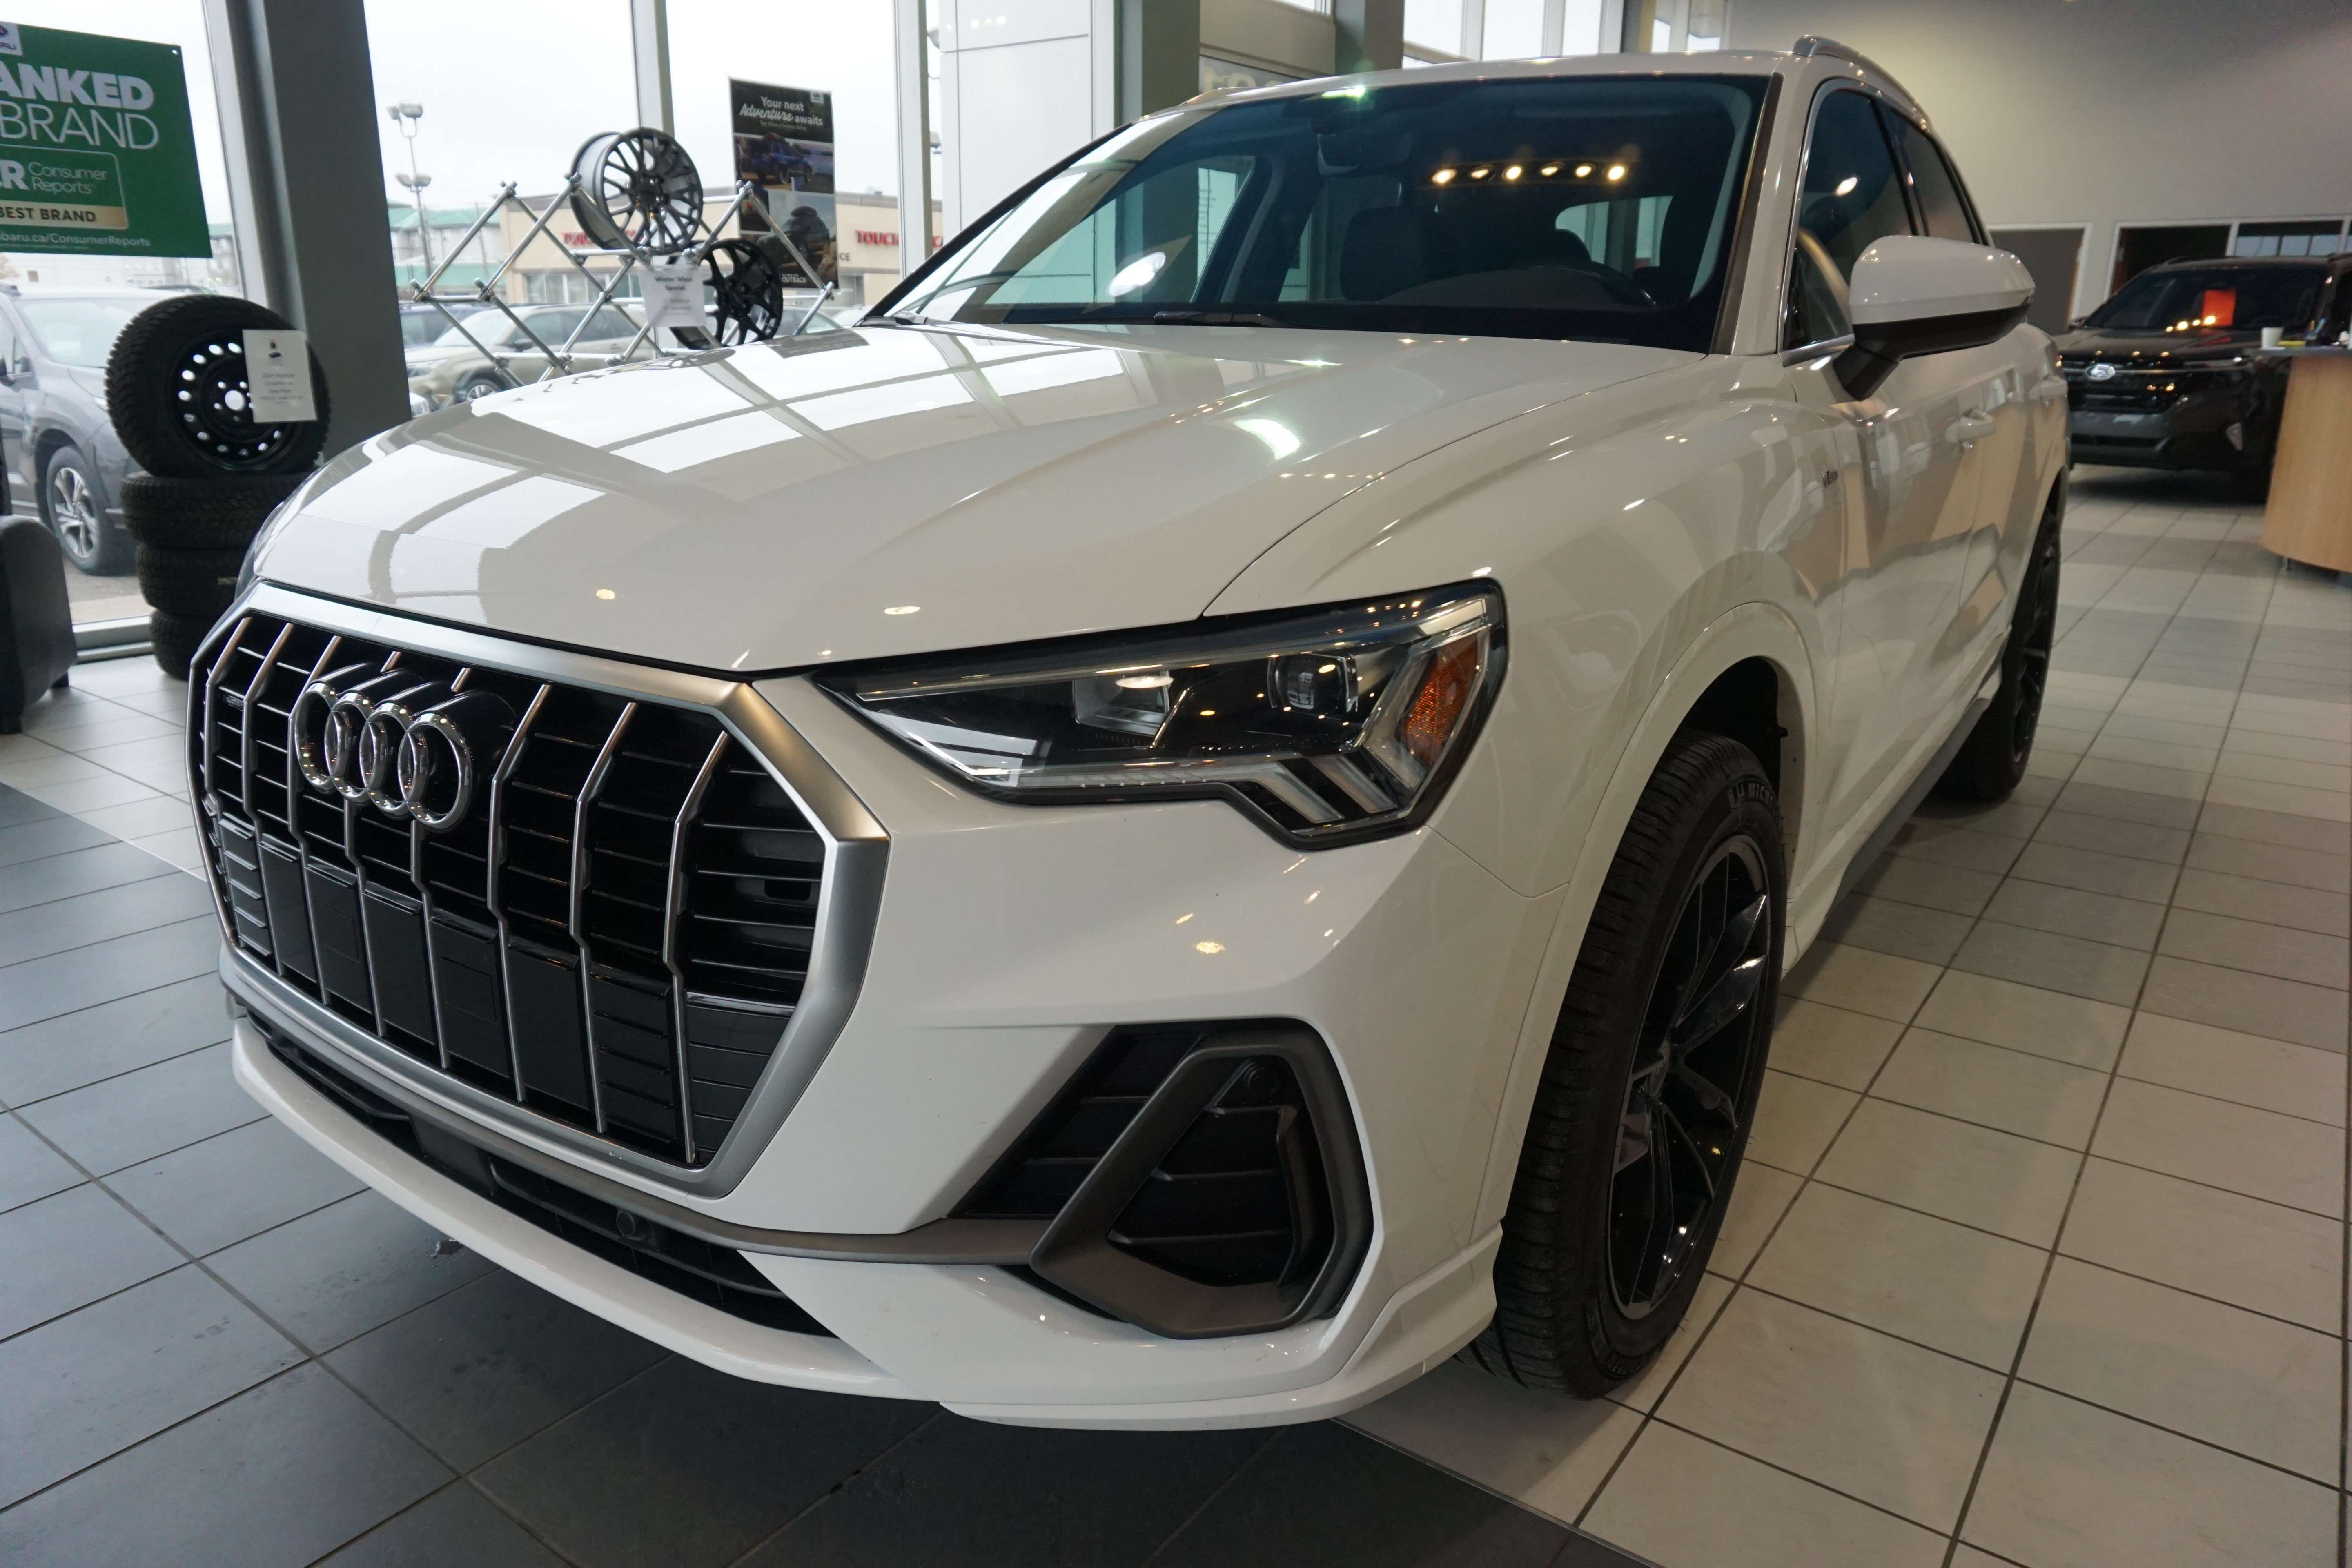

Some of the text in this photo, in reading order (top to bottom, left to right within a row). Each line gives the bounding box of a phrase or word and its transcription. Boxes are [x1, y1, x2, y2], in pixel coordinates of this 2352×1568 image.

[761, 96, 804, 111] Your next
[0, 100, 158, 149] BRAND
[739, 103, 823, 126] Adventure awaits
[0, 159, 107, 190] R Consumer
[31, 177, 92, 195] Reports
[40, 208, 96, 222] BRAND
